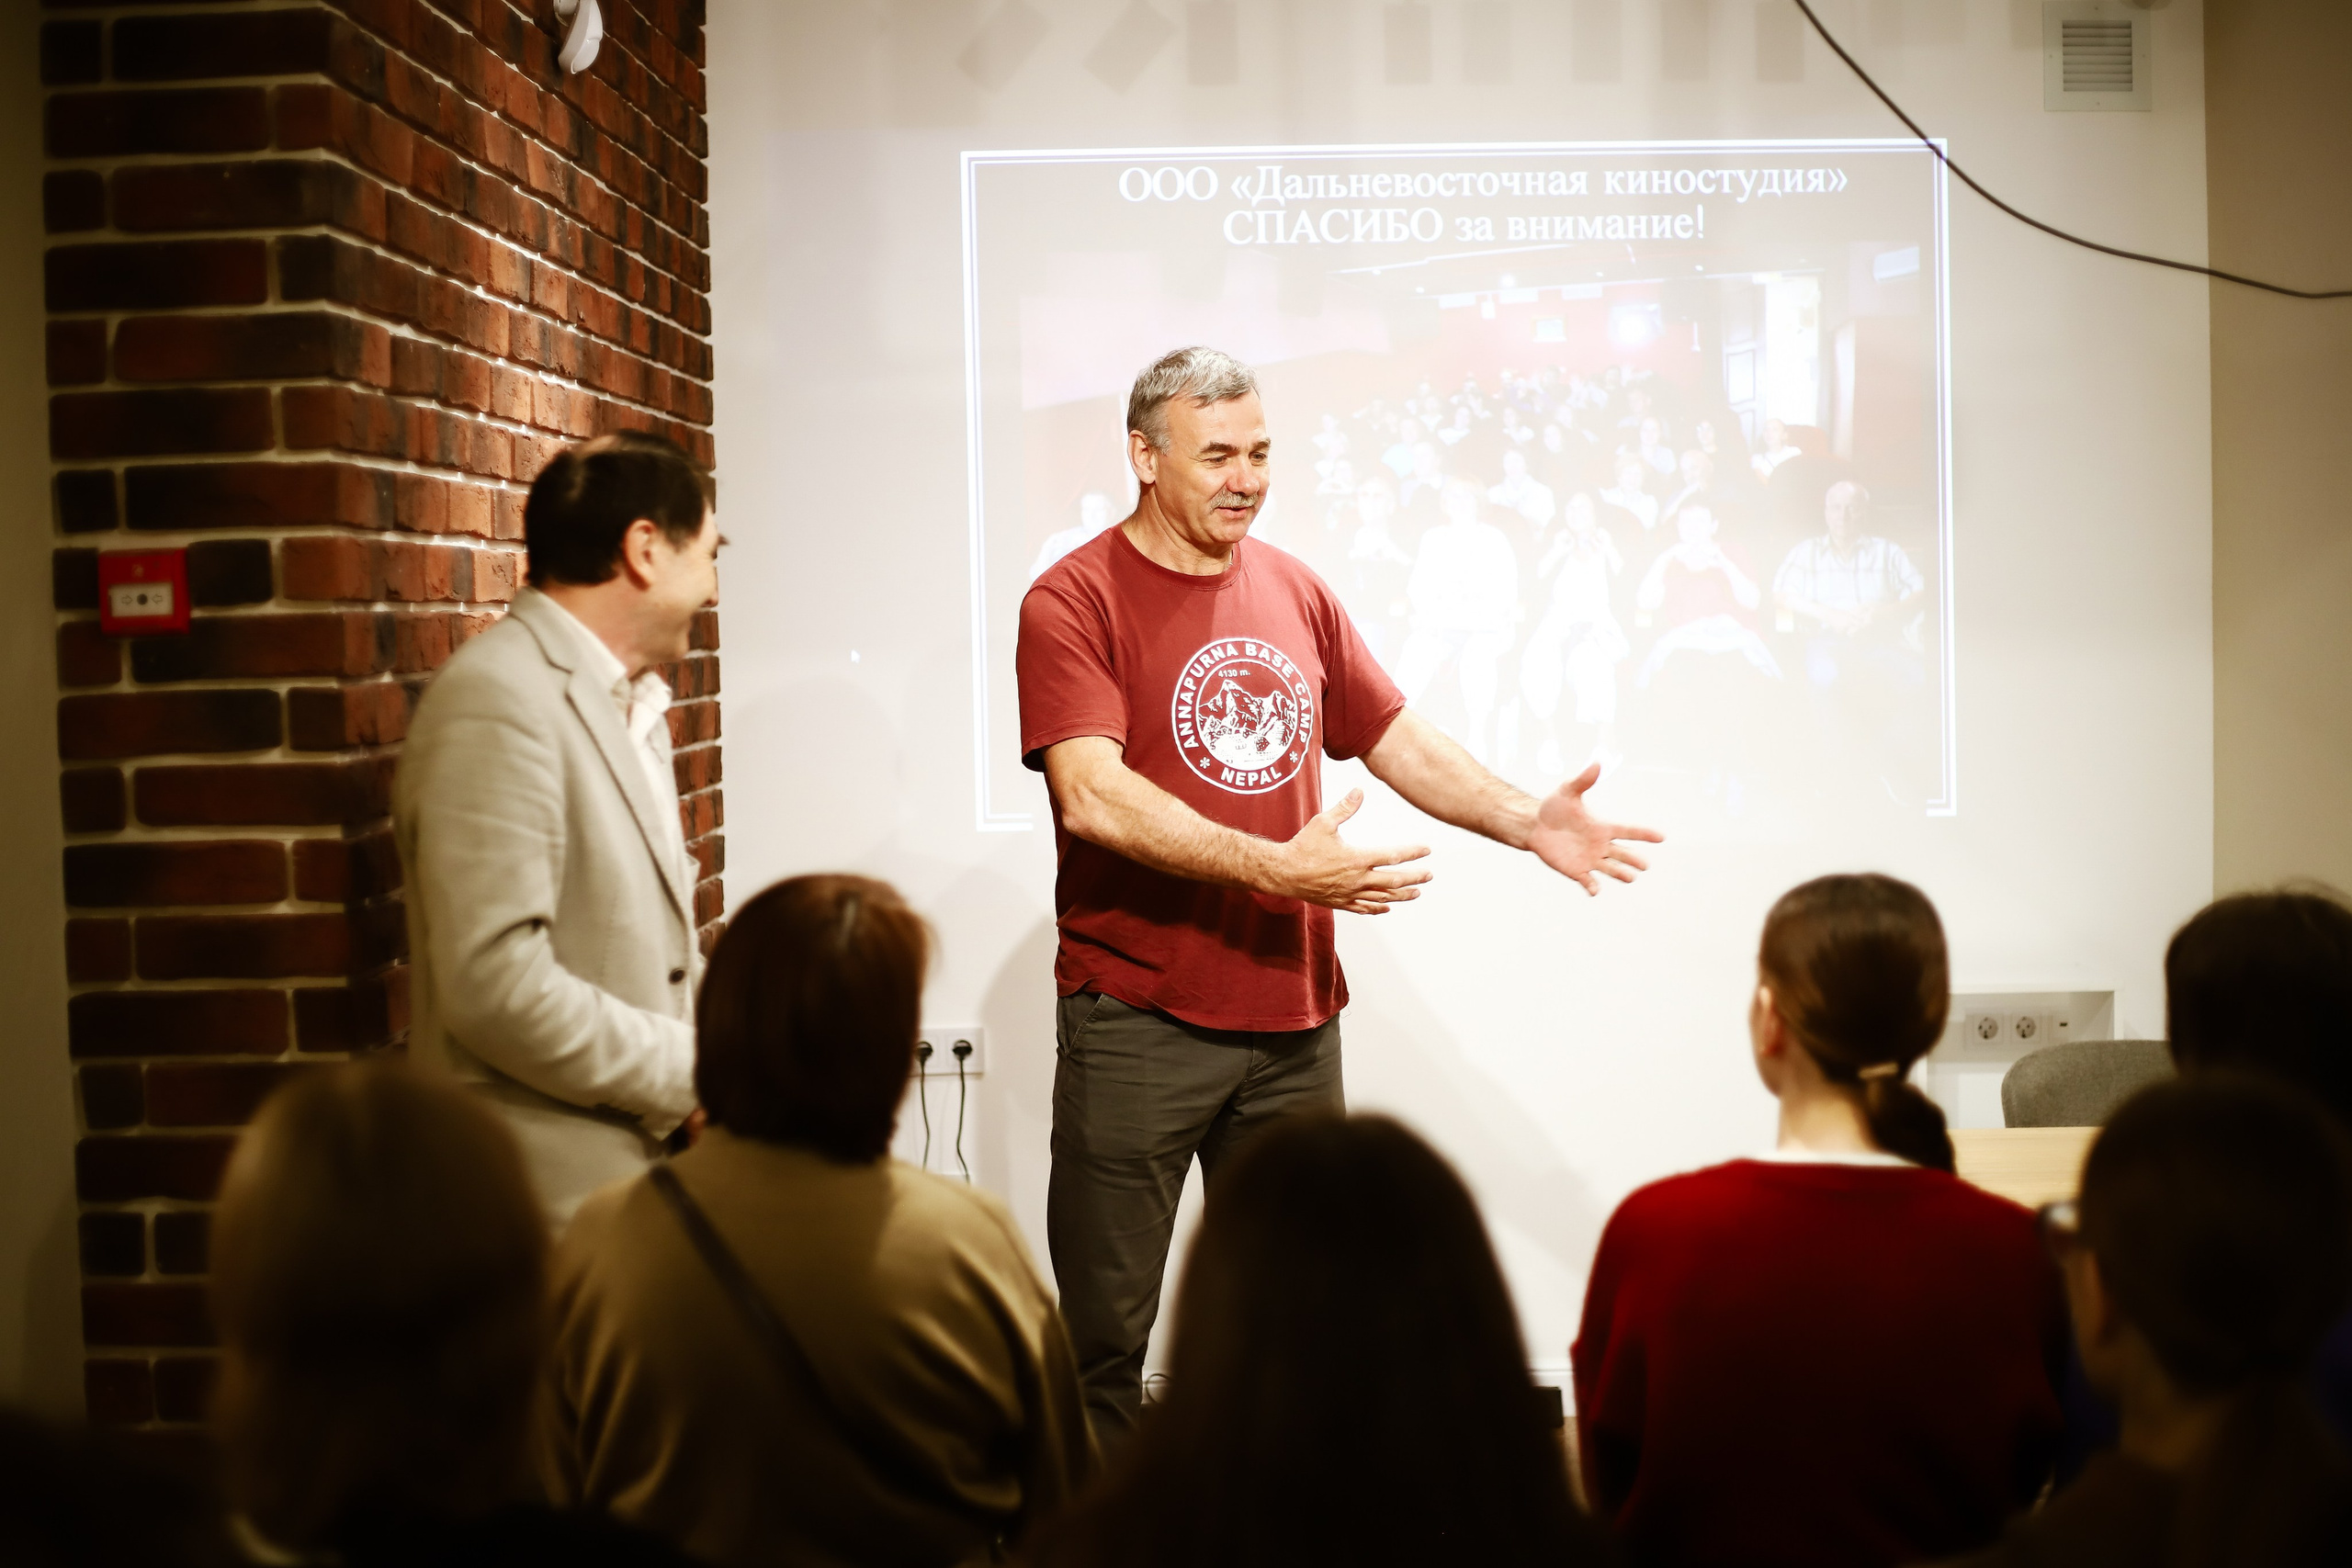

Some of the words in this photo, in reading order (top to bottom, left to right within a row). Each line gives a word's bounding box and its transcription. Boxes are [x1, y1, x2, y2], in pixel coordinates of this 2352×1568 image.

[1118, 165, 1219, 202] ООО
[1229, 164, 1589, 207] «Дальневосточная
[1603, 165, 1849, 203] киностудия»
[1222, 208, 1443, 246] СПАСИБО
[1454, 214, 1495, 243] за
[1507, 205, 1706, 243] внимание!
[1217, 669, 1238, 678] 4130
[1178, 643, 1238, 749] ANNAPURNA
[1245, 643, 1294, 679] BASE
[1295, 682, 1311, 743] CAMP
[1220, 766, 1283, 787] NEPAL
